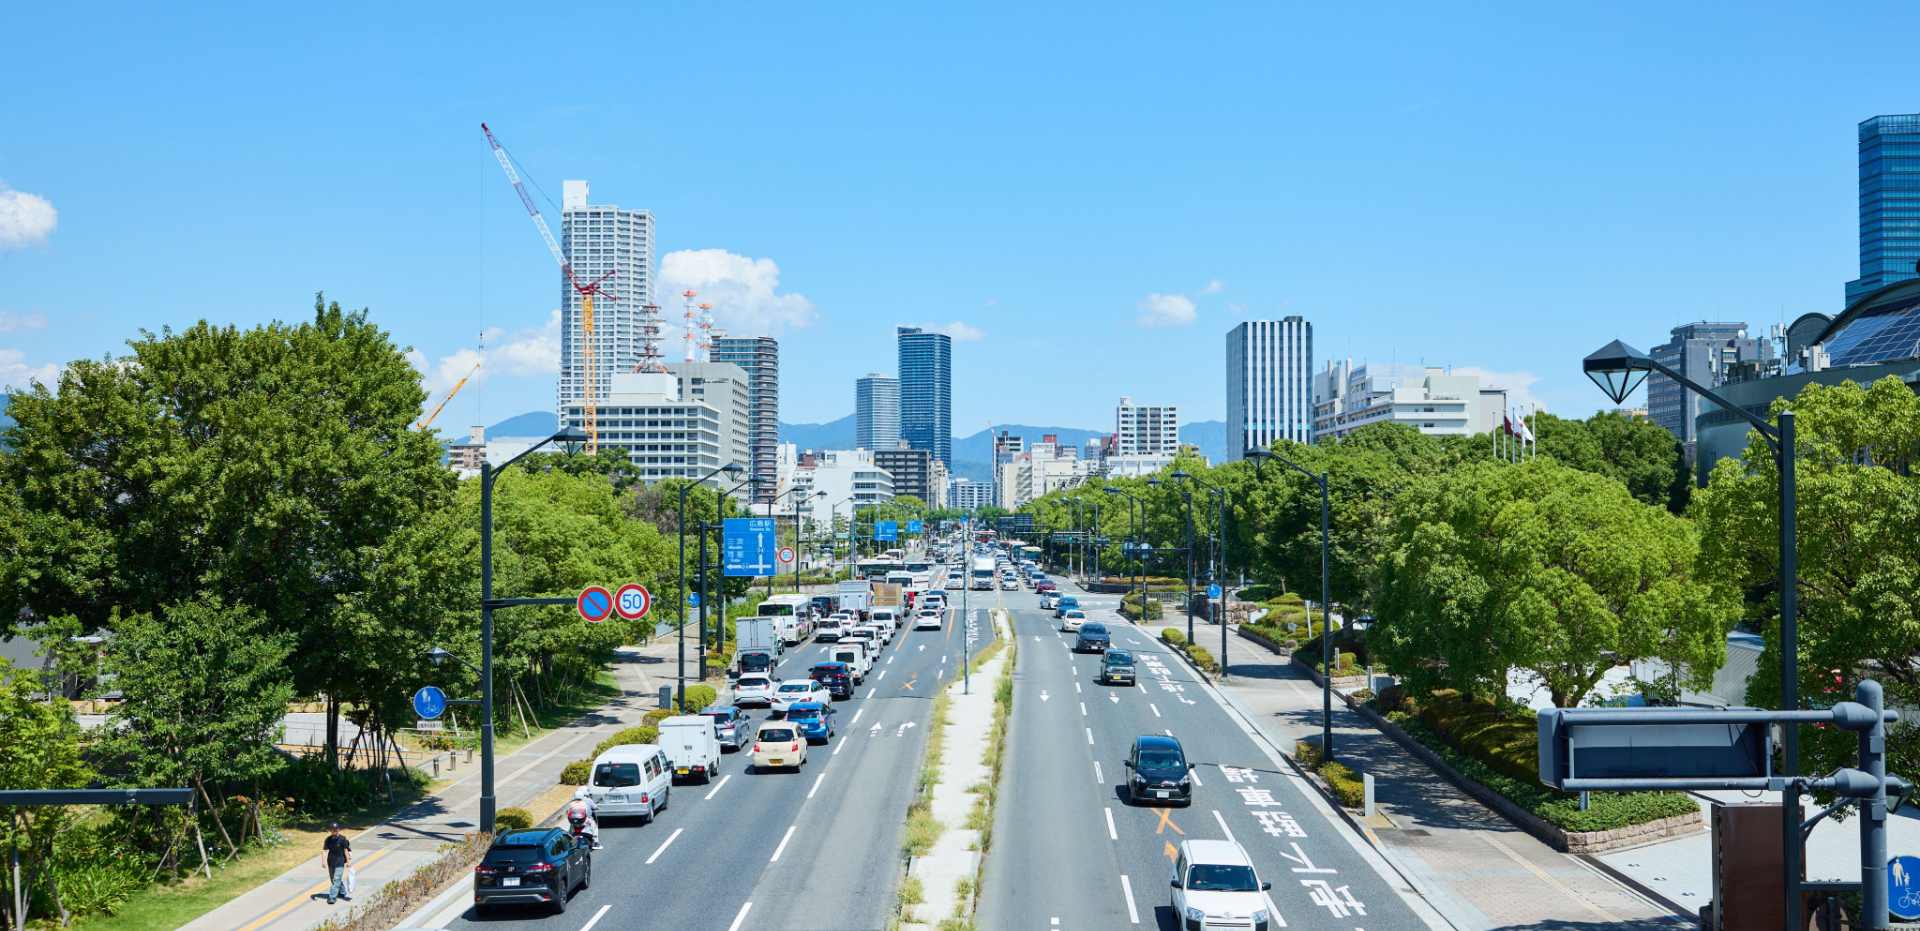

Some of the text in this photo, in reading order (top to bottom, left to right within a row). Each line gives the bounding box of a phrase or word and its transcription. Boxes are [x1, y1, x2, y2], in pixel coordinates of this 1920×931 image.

[623, 594, 642, 609] 50
[1219, 764, 1367, 919] 地下駐車場
